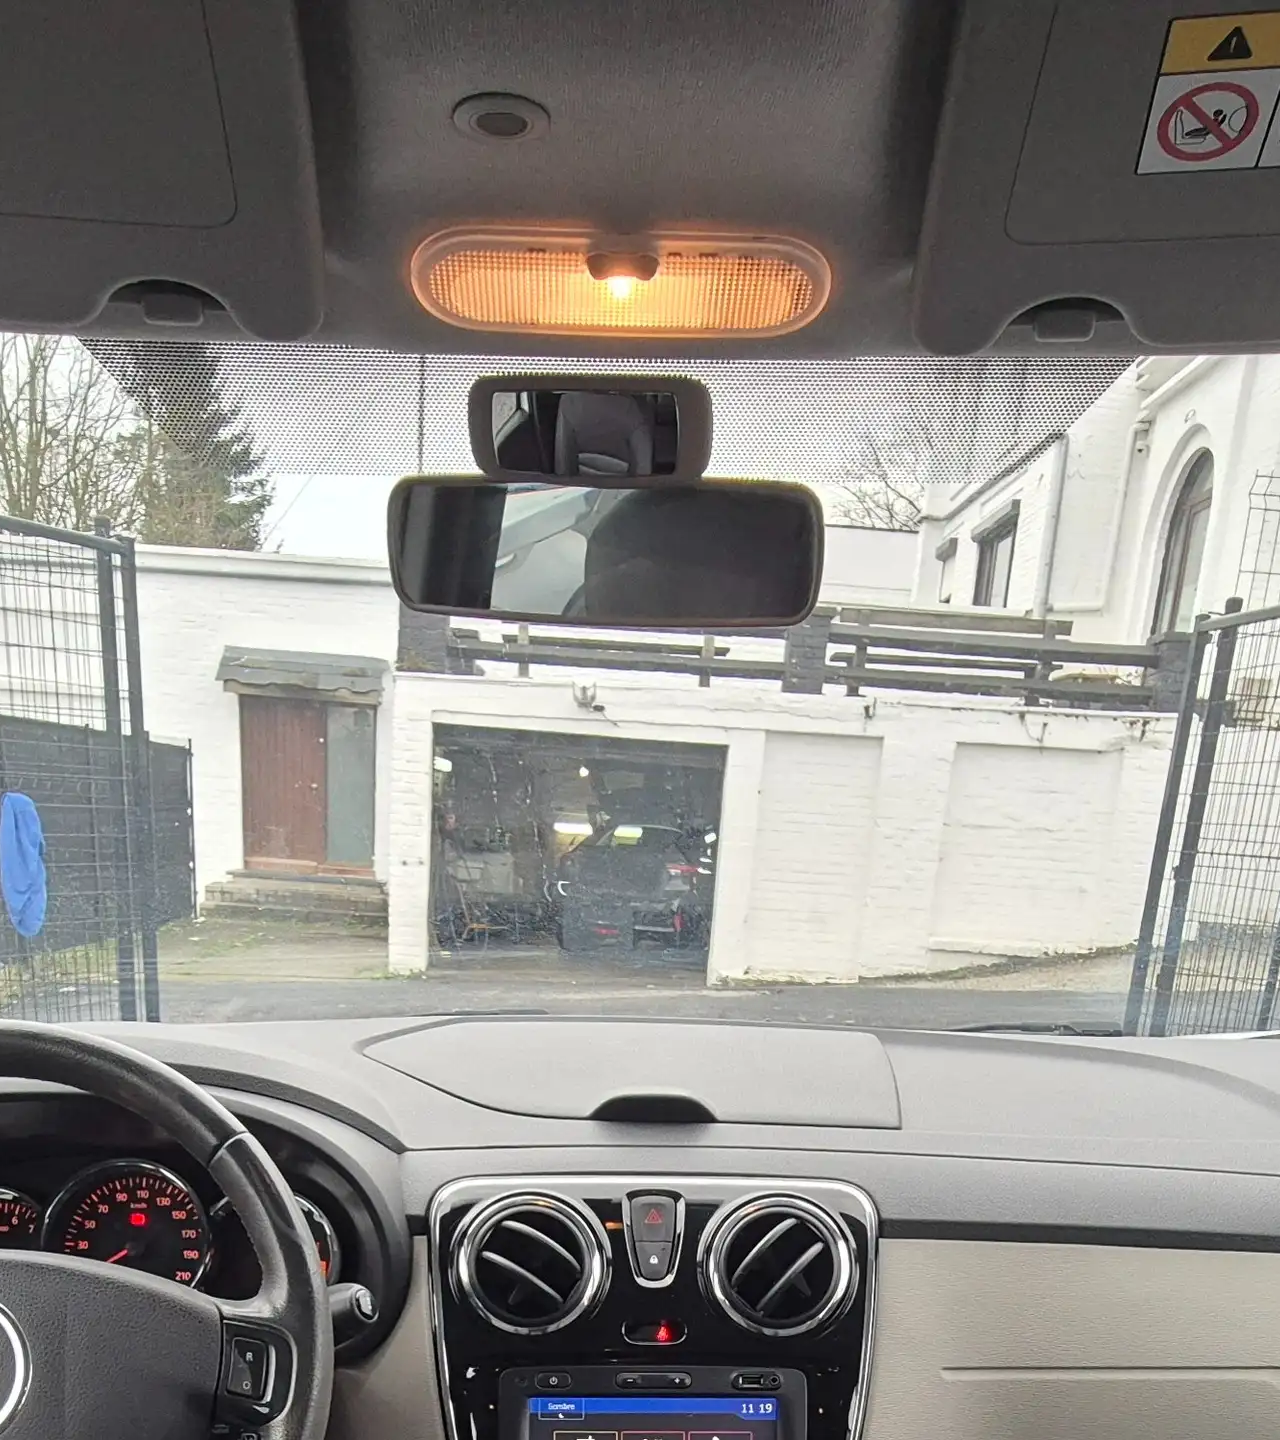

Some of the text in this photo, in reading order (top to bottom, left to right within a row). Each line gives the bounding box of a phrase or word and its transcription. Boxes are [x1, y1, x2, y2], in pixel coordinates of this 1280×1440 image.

[116, 1192, 128, 1202] 90
[136, 1190, 150, 1199] 110
[156, 1197, 171, 1206] 130
[97, 1204, 109, 1213] 70
[171, 1210, 187, 1220] 150
[11, 1216, 18, 1225] 6
[84, 1220, 96, 1229] 50
[28, 1224, 35, 1234] 7
[181, 1229, 197, 1238] 170
[77, 1240, 89, 1250] 30
[183, 1250, 199, 1260] 190
[175, 1271, 191, 1281] 210
[245, 1352, 254, 1362] R
